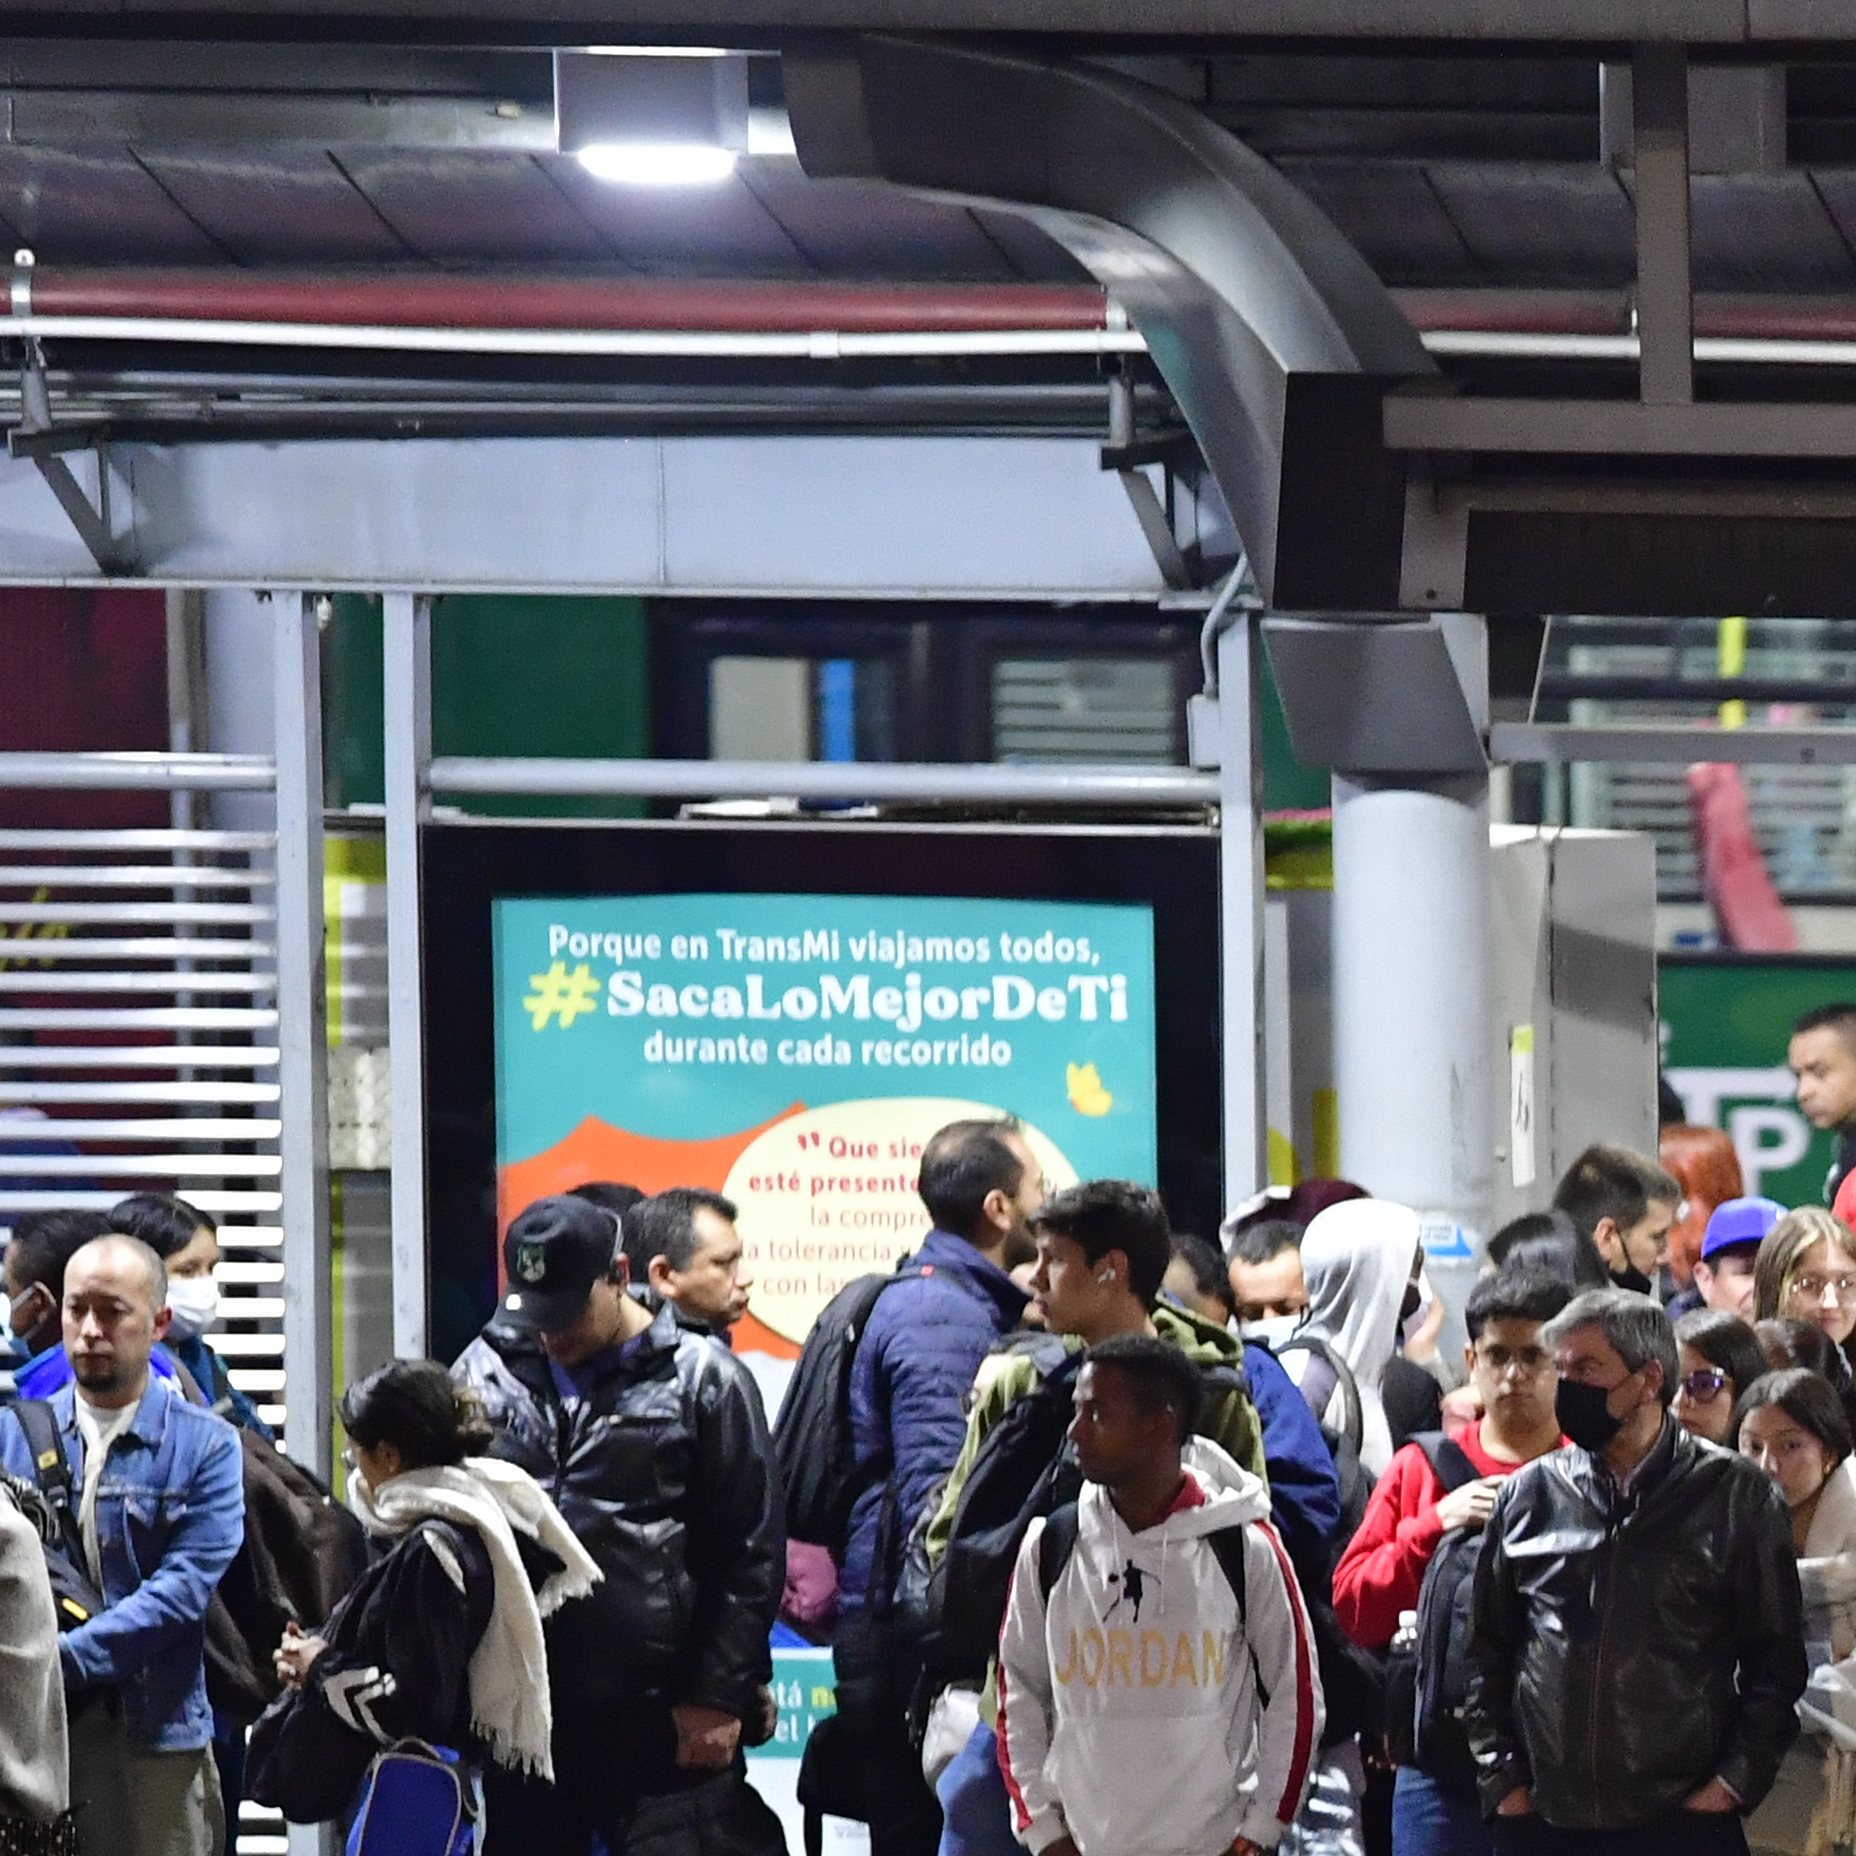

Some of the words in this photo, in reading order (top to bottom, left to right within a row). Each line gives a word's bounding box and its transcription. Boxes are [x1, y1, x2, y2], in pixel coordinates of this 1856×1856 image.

[549, 924, 662, 965] Porque
[671, 933, 709, 960] en
[716, 928, 840, 962] TransMi
[849, 930, 991, 969] viajamos
[1000, 930, 1099, 966] todos,
[522, 961, 1128, 1032] #SacaLoMejorDeTi
[644, 1029, 768, 1064] durante
[777, 1033, 851, 1065] cada
[861, 1032, 1012, 1067] recorrido
[750, 1171, 801, 1193] esté
[811, 1204, 830, 1227] la
[840, 1209, 931, 1233] compre
[770, 1238, 891, 1261] tolerancia
[763, 1278, 807, 1295] con
[1055, 1629, 1225, 1688] JORDAN
